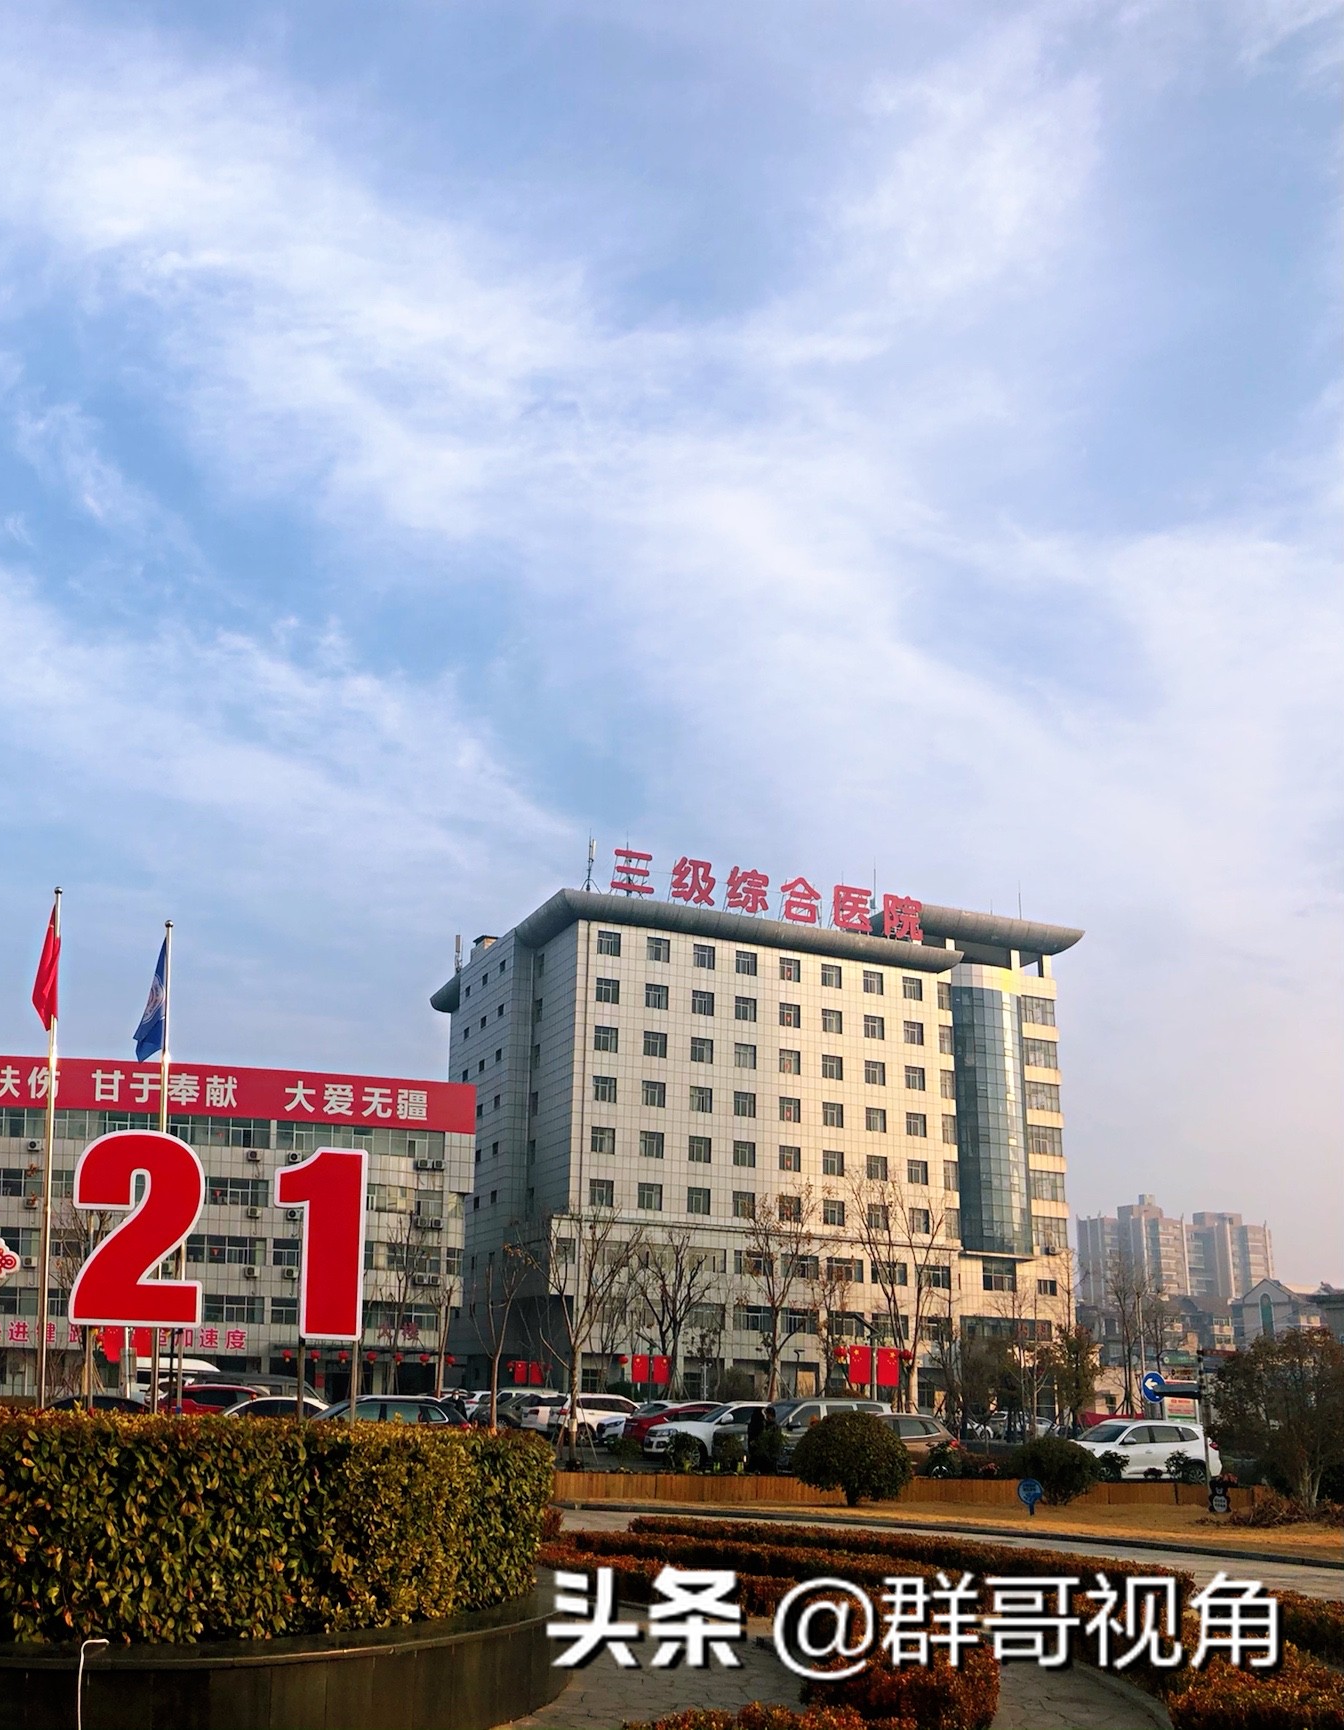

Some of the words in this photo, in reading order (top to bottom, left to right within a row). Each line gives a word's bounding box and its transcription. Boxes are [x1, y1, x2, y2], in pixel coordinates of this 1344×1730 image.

[610, 848, 924, 942] 三级综合医院
[91, 1069, 237, 1108] 甘于奉献
[284, 1080, 429, 1121] 大爱无疆
